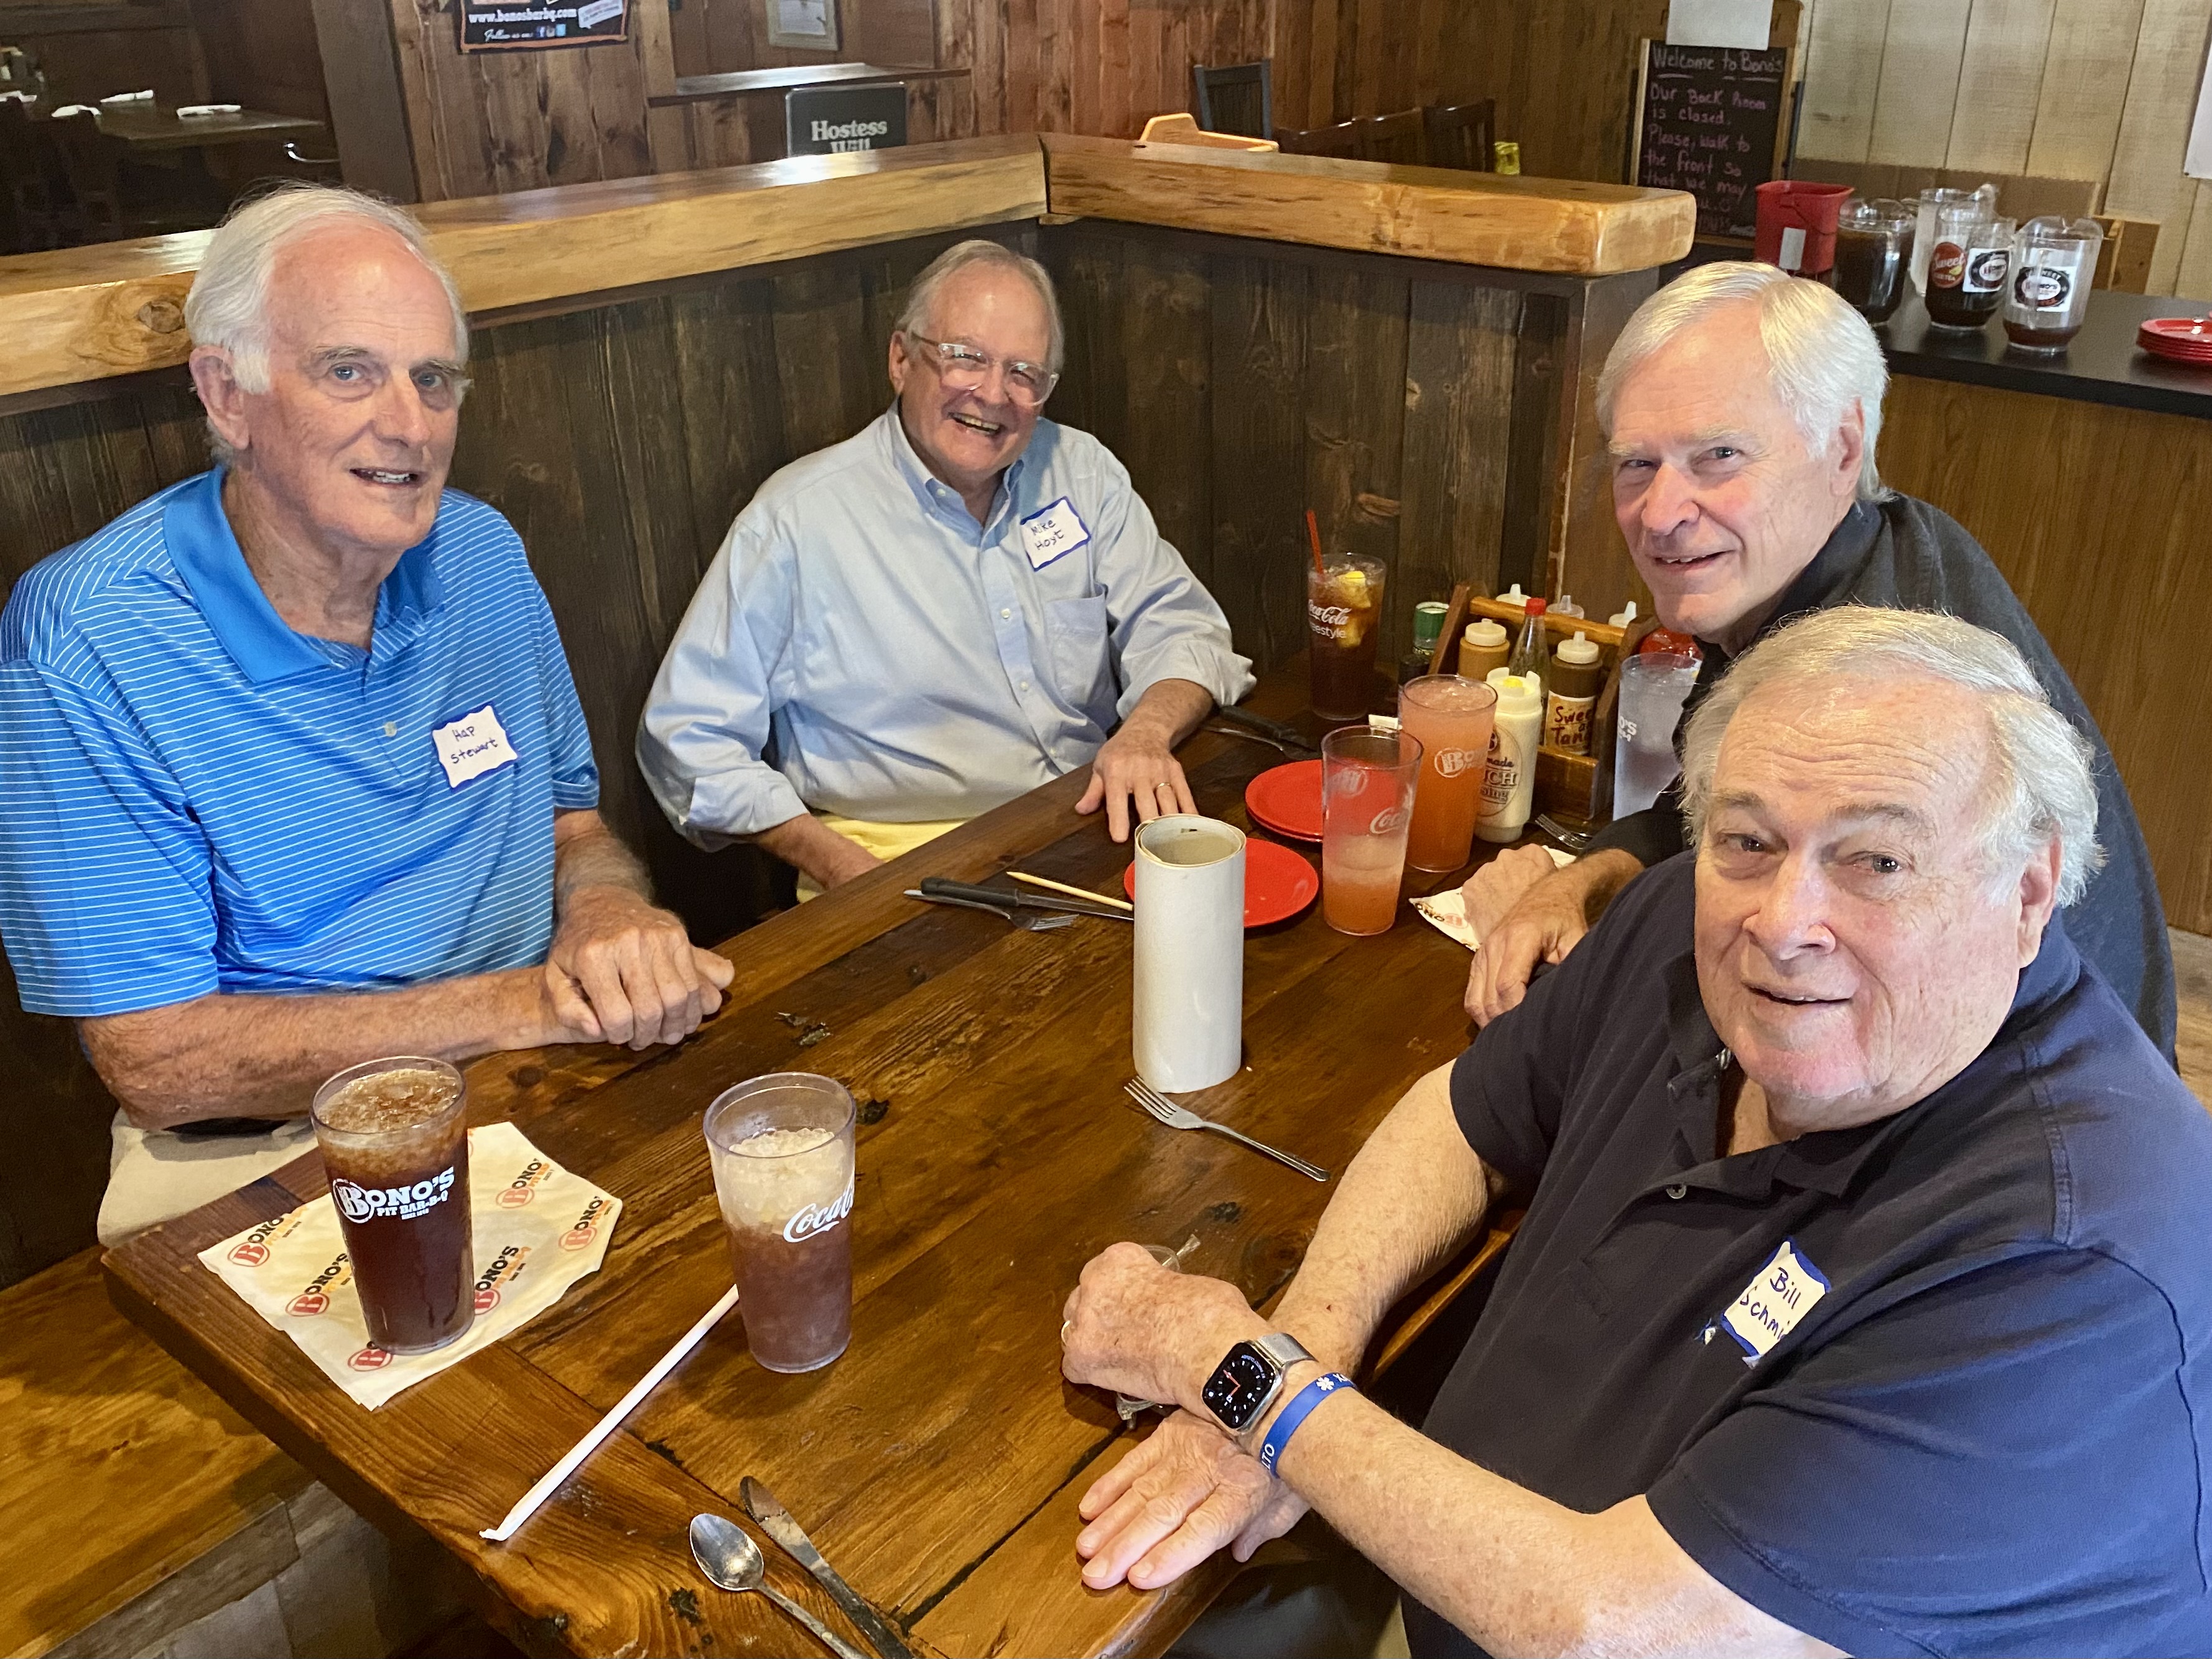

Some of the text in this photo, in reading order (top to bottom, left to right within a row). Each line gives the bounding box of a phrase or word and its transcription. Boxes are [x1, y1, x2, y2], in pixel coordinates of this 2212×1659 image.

[1652, 44, 1715, 70] Welcome
[1722, 49, 1737, 72] to
[1650, 83, 1678, 101] Our
[1652, 104, 1666, 119] is
[811, 119, 888, 141] Hostess
[1034, 529, 1064, 551] Hoyt
[450, 738, 498, 764] Stewart
[333, 1166, 455, 1224] BONO'S
[377, 1206, 397, 1217] PIT
[399, 1189, 448, 1214] BAR-B-Q
[1770, 1266, 1801, 1310] Bill
